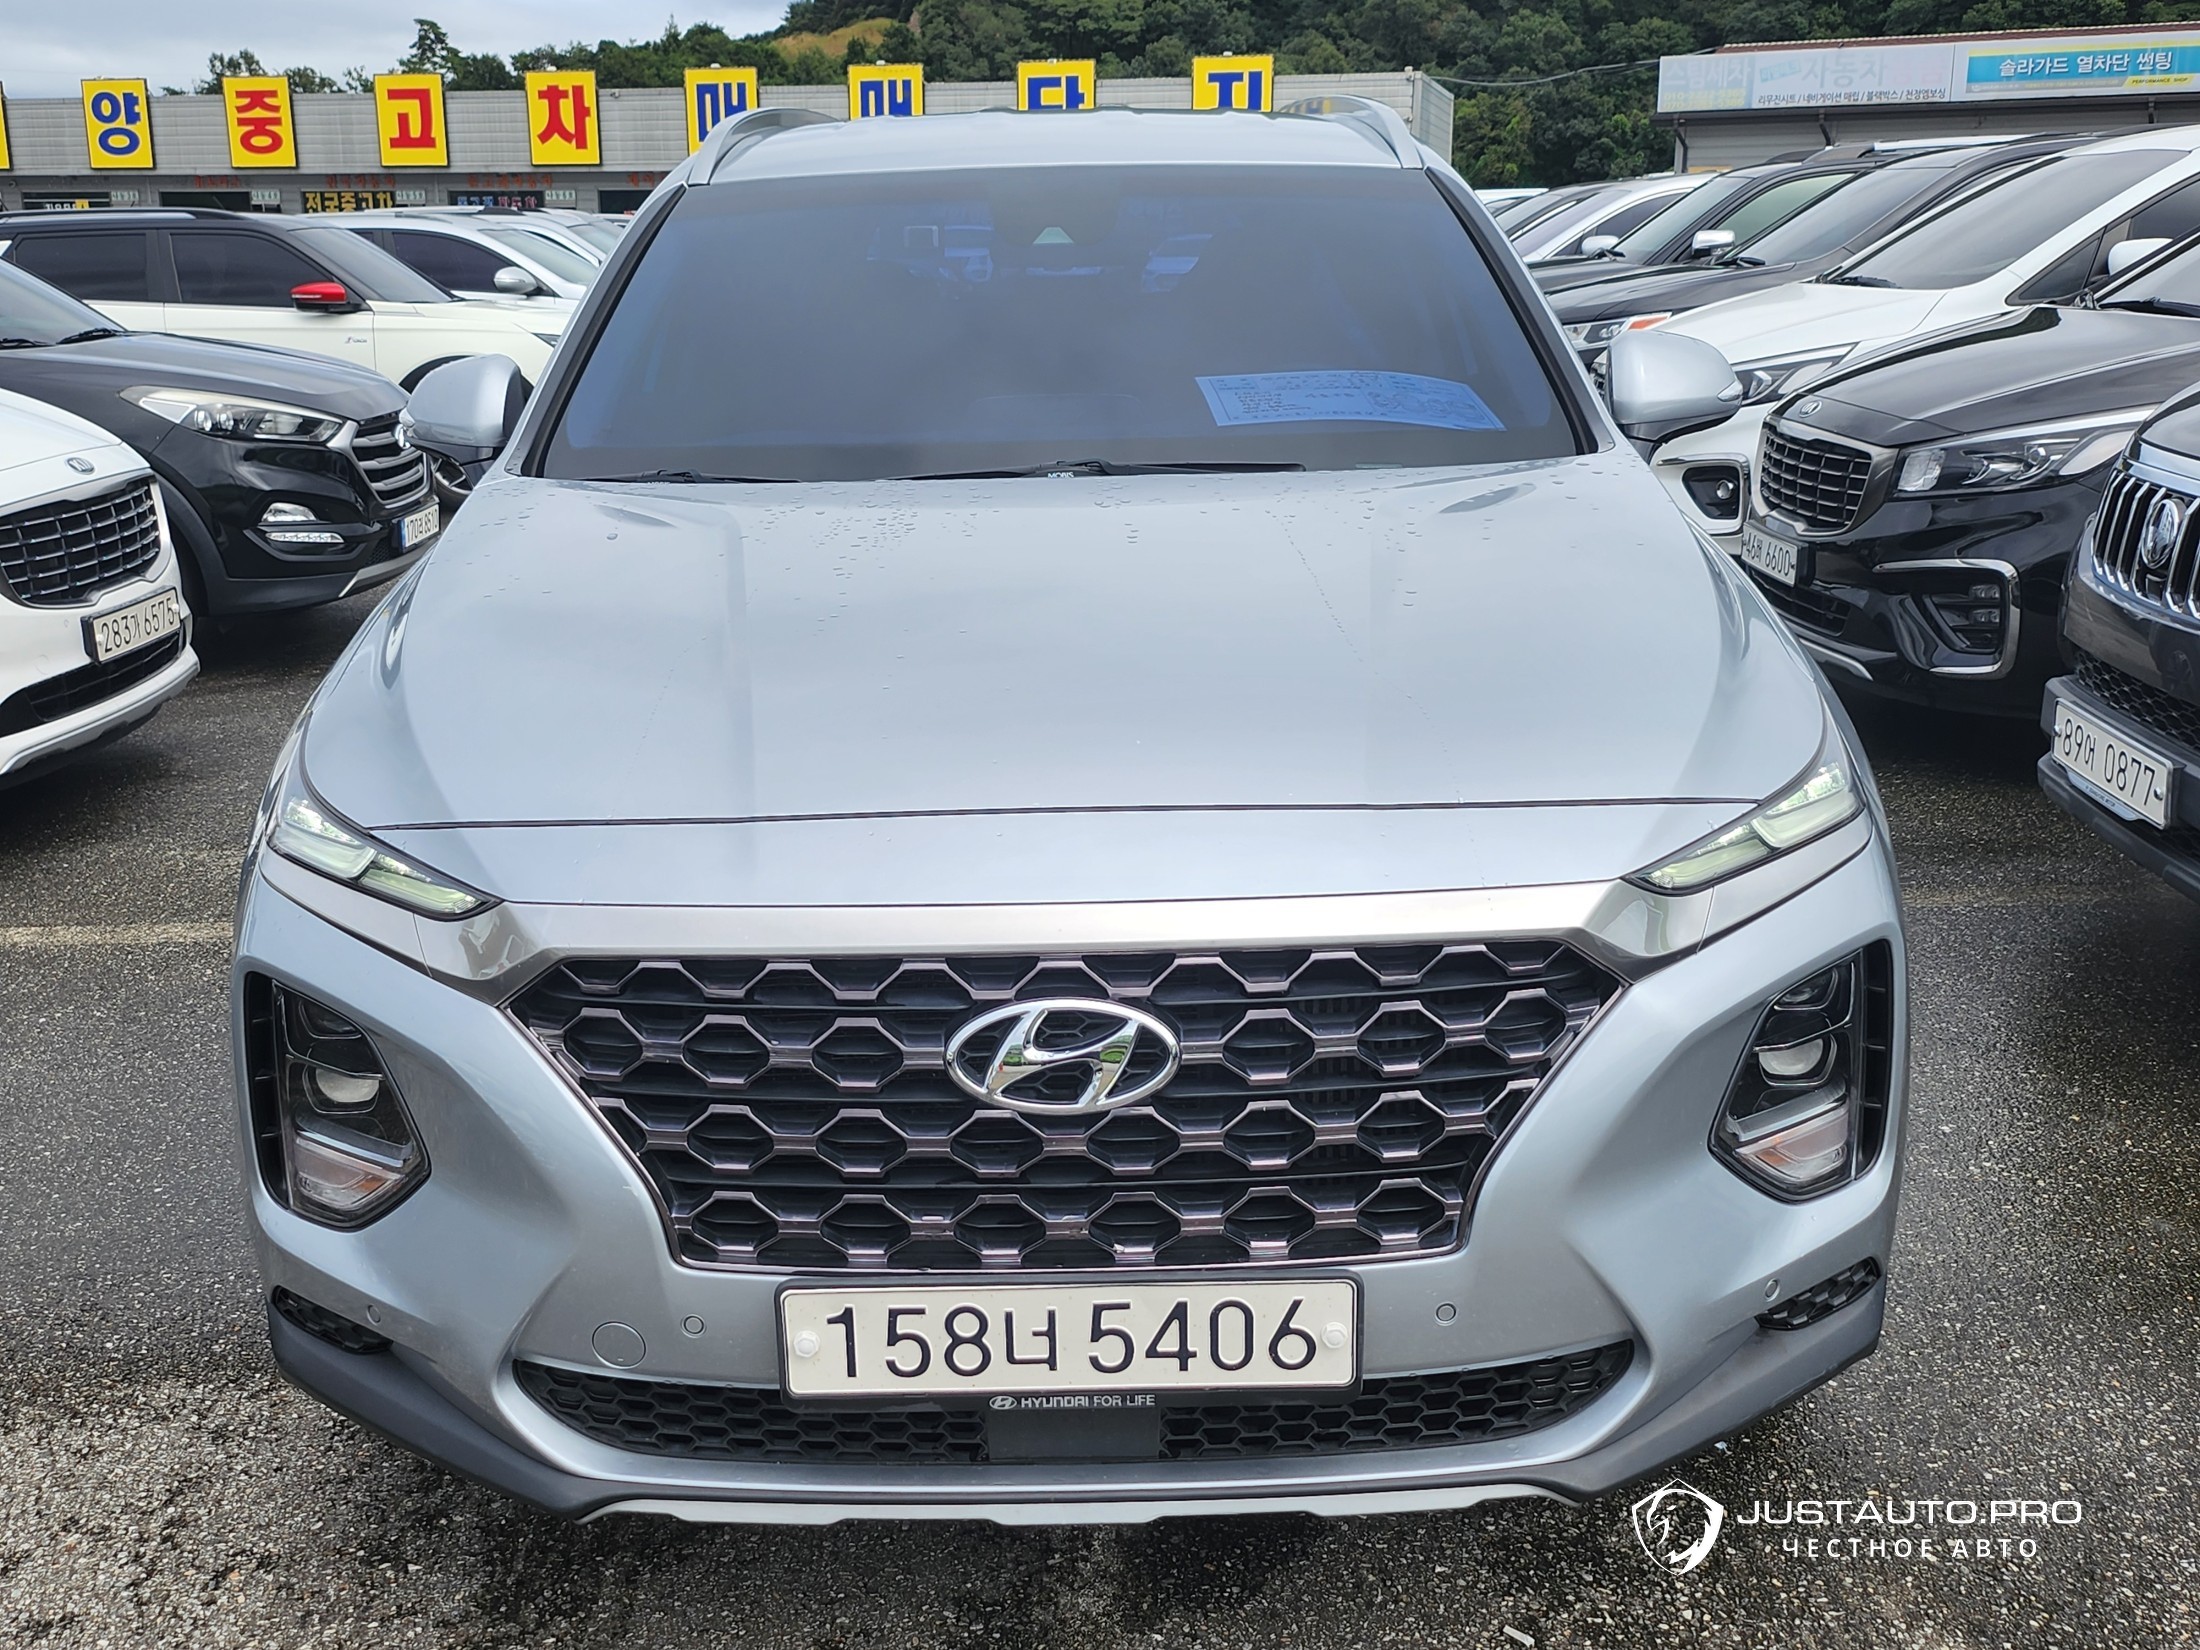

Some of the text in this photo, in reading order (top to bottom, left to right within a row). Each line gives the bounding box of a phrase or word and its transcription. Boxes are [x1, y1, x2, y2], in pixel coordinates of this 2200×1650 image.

[2000, 52, 2173, 77] 솔라가드 열차단 썬팅
[91, 91, 141, 155] 양
[1765, 542, 1791, 576] 6600
[101, 597, 175, 653] 283가 6575
[2063, 718, 2155, 806] 89어 0877
[825, 1298, 1318, 1379] 158너 5406
[1021, 1394, 1156, 1408] HYUNDAI FOR LIFE
